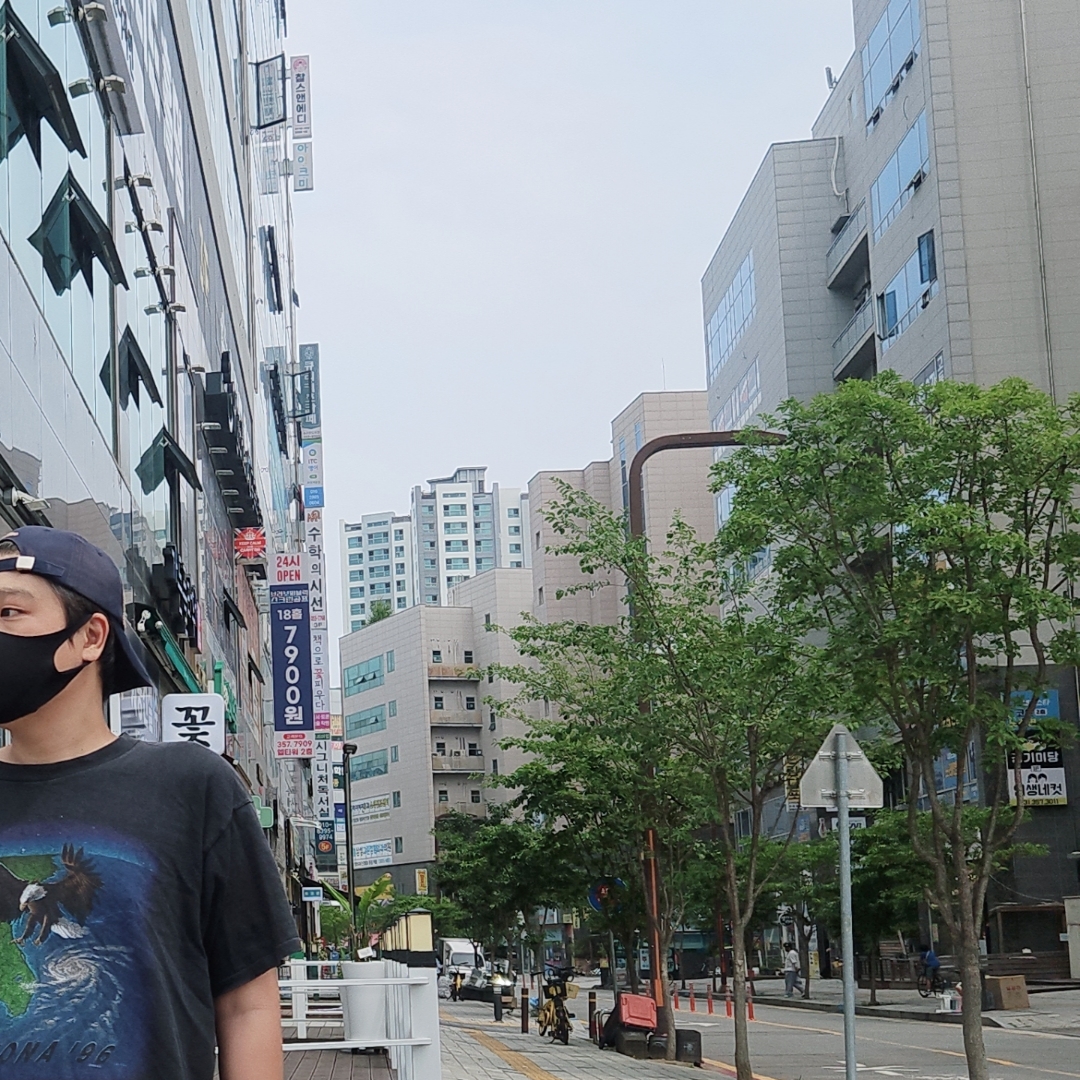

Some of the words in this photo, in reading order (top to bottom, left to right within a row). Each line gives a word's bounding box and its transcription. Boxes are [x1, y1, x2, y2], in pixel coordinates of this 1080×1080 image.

[276, 554, 300, 568] 24시
[276, 569, 301, 582] OPEN
[276, 608, 303, 620] 18홀
[283, 625, 305, 725] 7900원
[171, 706, 216, 747] 꽃
[316, 740, 330, 818] 시그니처독서실
